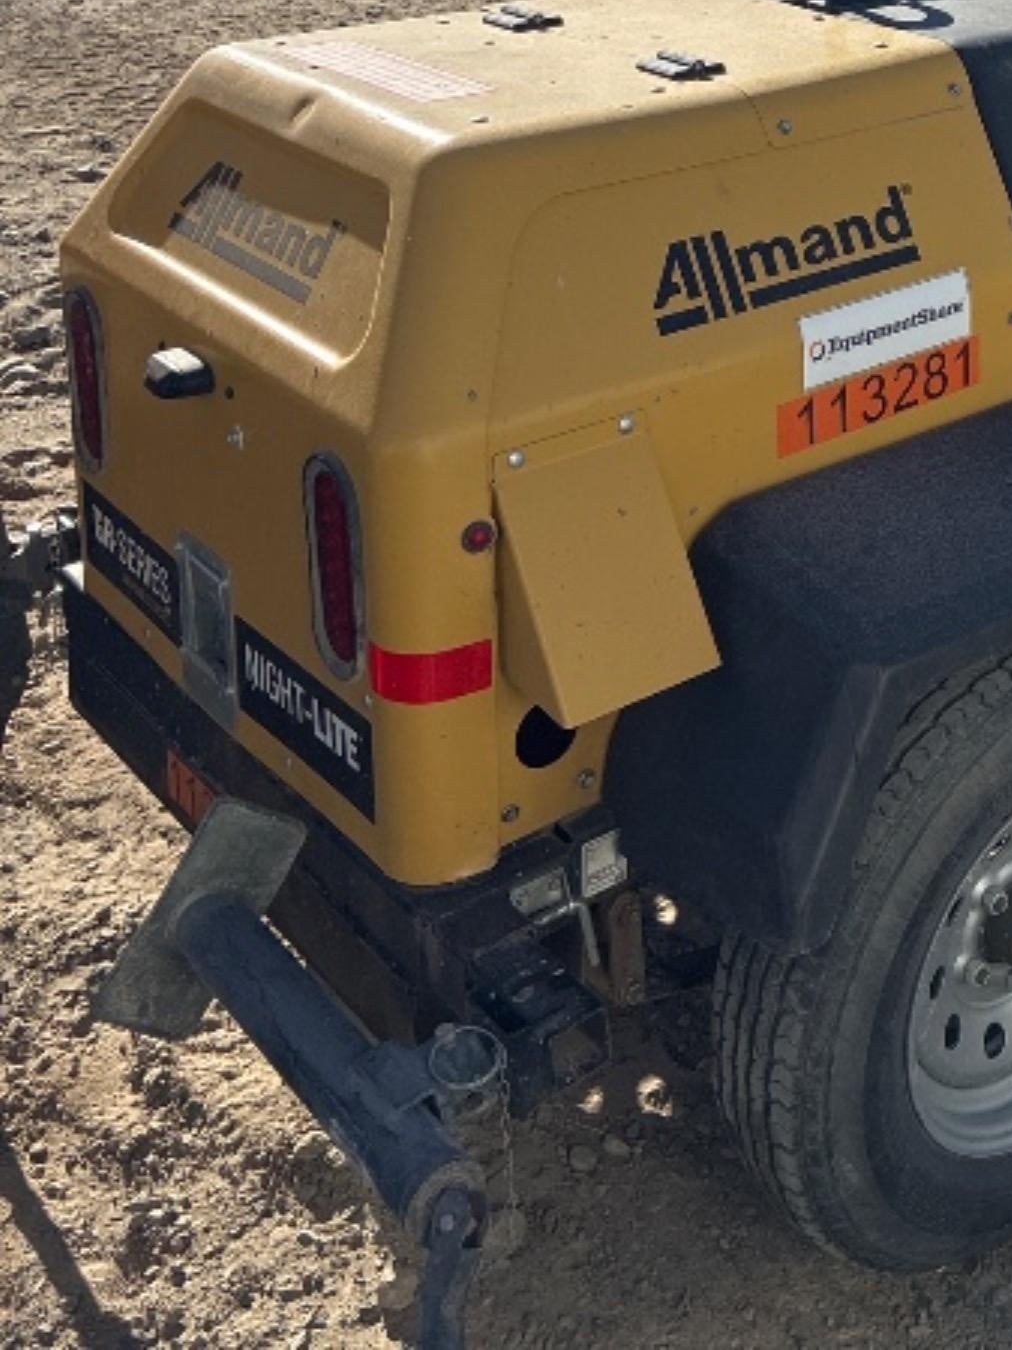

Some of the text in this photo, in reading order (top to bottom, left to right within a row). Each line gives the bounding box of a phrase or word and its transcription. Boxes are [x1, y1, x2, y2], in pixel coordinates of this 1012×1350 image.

[178, 161, 347, 281] Allmand
[653, 185, 913, 320] Allmand
[797, 341, 972, 446] 113281
[244, 642, 361, 772] NIGHT-LITE
